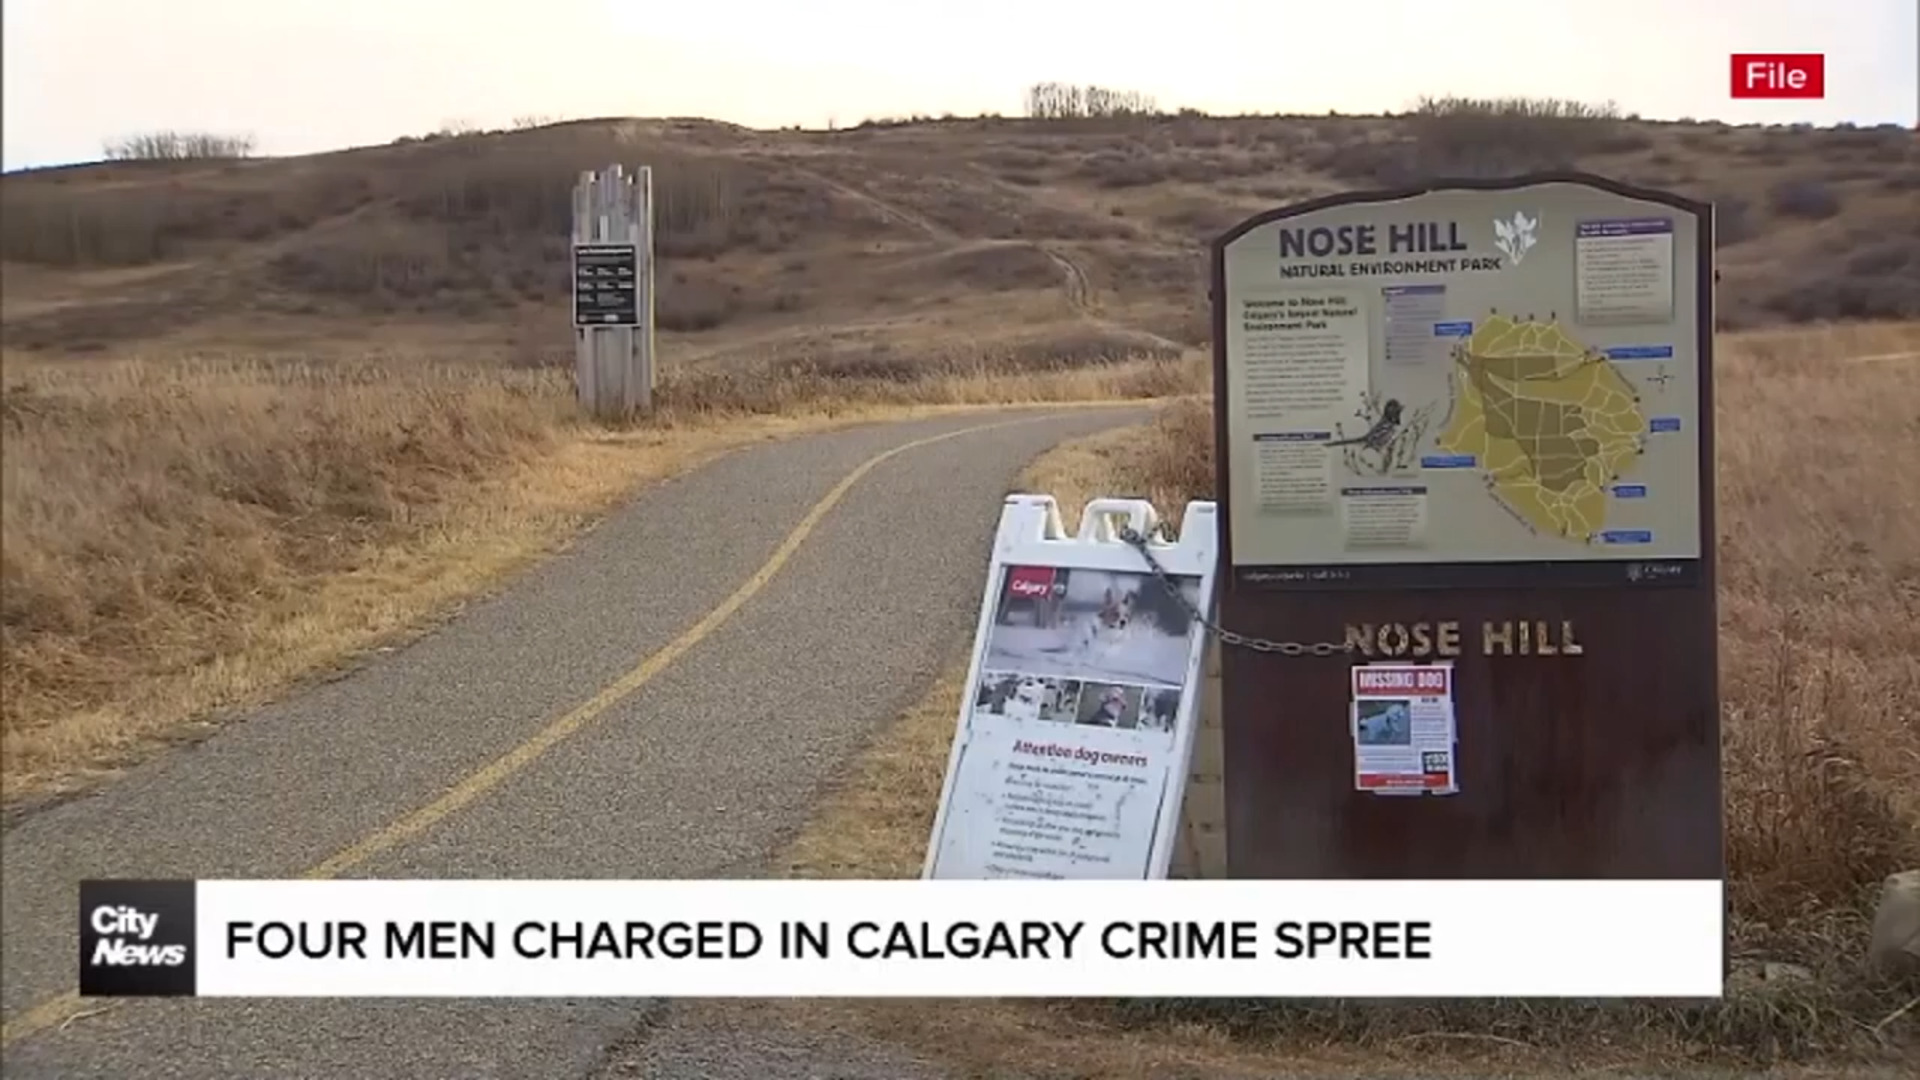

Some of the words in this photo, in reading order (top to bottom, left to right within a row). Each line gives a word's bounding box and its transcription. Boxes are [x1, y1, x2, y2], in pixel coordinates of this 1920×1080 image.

[1279, 225, 1377, 258] NOSE
[1388, 221, 1468, 253] HILL
[1280, 262, 1346, 279] NATURAL
[1349, 259, 1457, 276] ENVIRONMENT
[1460, 256, 1503, 272] PARK
[1012, 579, 1049, 595] Calgary
[1344, 620, 1461, 656] NOSE
[1482, 620, 1584, 655] HILL
[1359, 671, 1414, 689] MISSING
[1418, 671, 1444, 688] DOG
[1012, 738, 1073, 759] Attention
[1074, 747, 1099, 766] dog
[1100, 751, 1149, 768] owners
